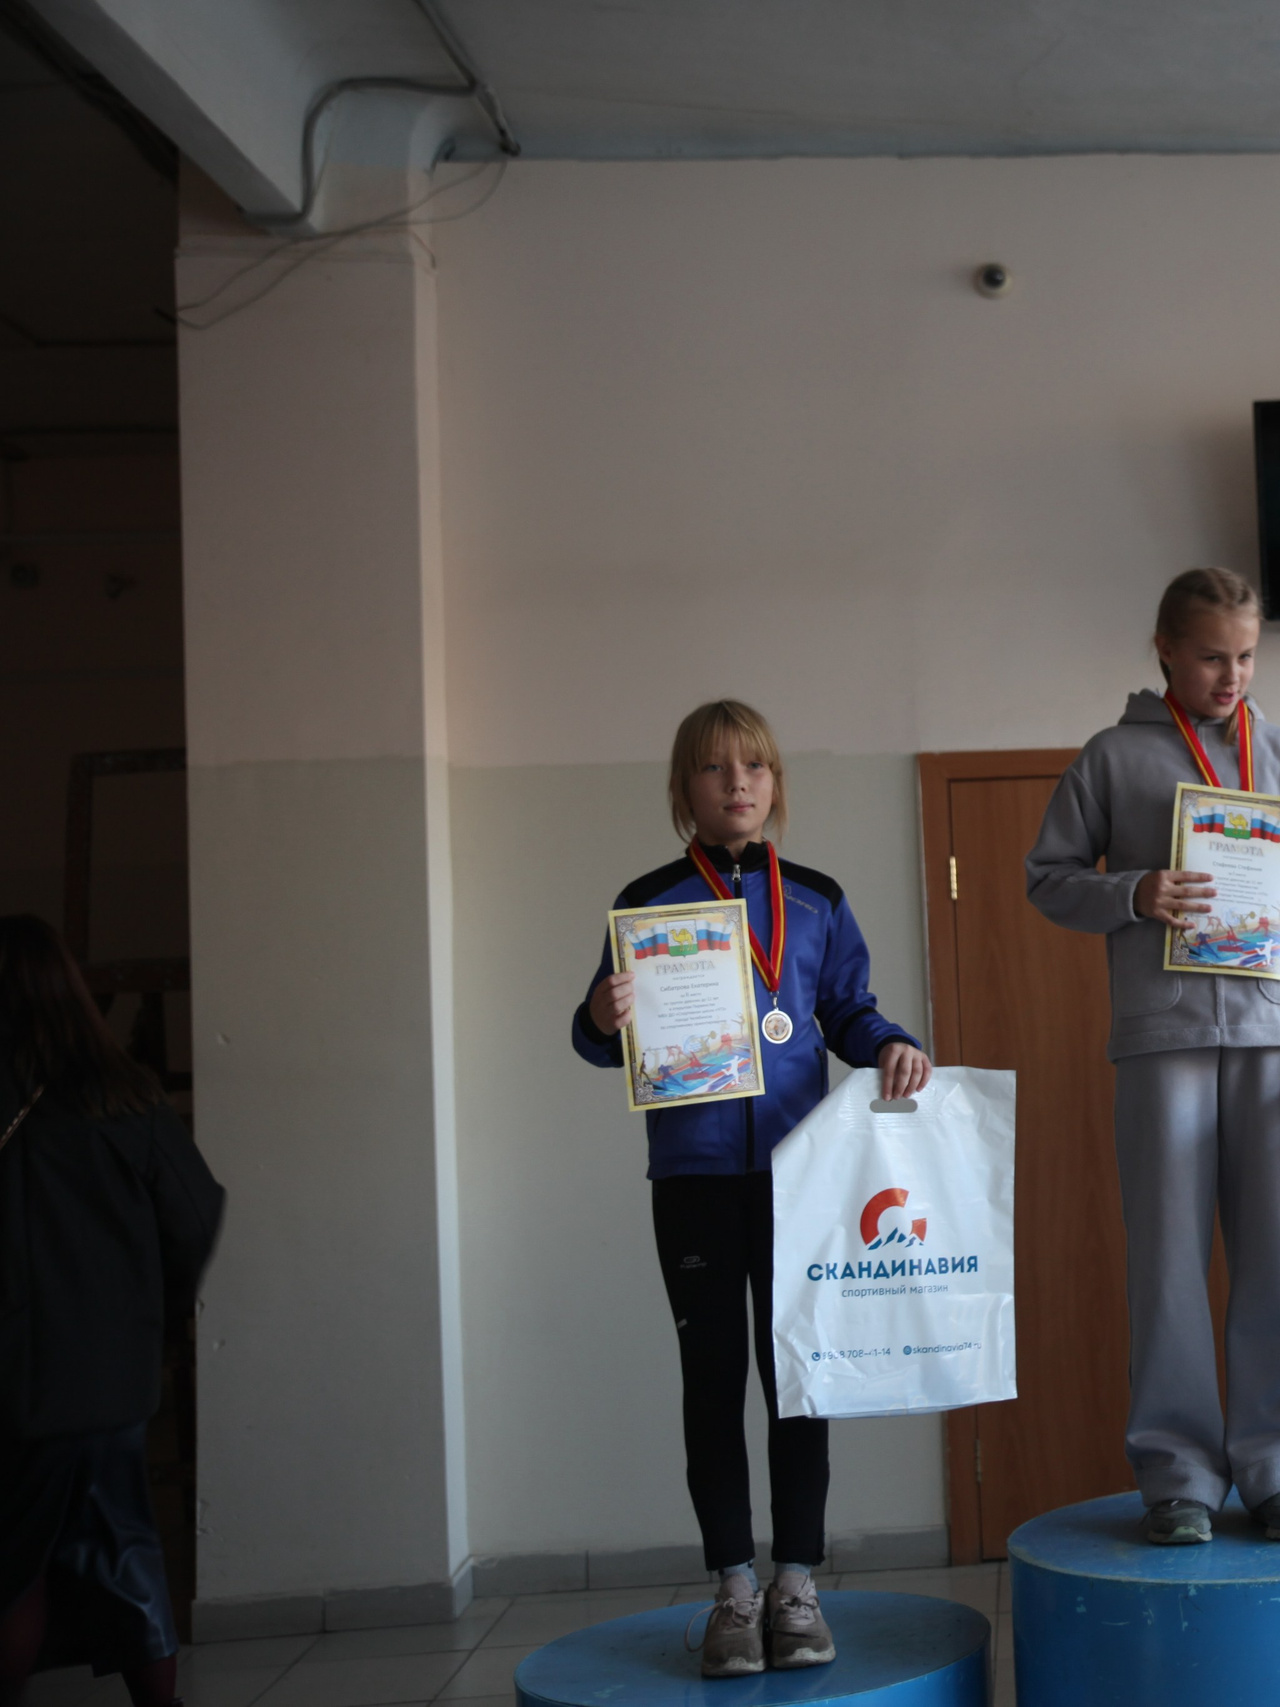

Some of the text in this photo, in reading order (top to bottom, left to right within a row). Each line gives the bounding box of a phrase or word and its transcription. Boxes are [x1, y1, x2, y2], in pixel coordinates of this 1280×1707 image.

[1208, 841, 1265, 857] ГРАМОТА
[656, 960, 716, 975] ГРАМОТА
[806, 1255, 979, 1281] СКАНДИНАВИЯ
[841, 1284, 948, 1298] спортивный магазин
